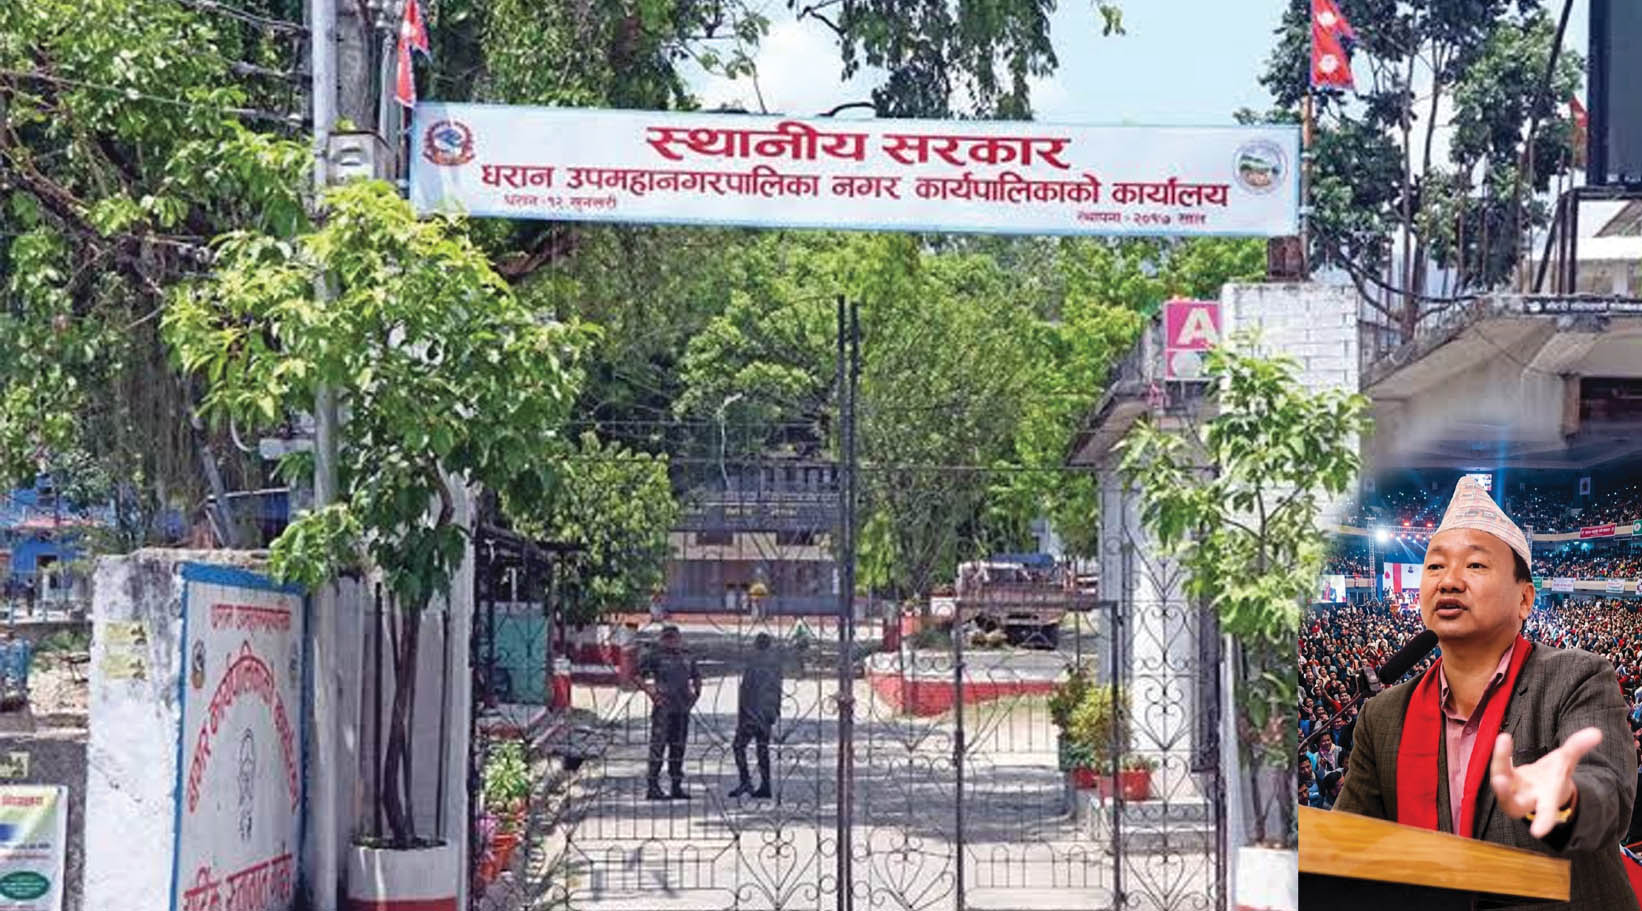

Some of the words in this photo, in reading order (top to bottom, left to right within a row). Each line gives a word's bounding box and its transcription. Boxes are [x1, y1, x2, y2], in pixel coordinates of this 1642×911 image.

[648, 121, 868, 161] स्थानीय
[882, 133, 1071, 170] सरकार
[481, 164, 553, 189] धरान
[567, 164, 819, 197] उपमहानगरपालिका
[832, 176, 901, 199] नगर
[915, 172, 1100, 205] कार्यपालिकाको
[1112, 178, 1230, 208] कार्यालय
[1176, 307, 1219, 345] A
